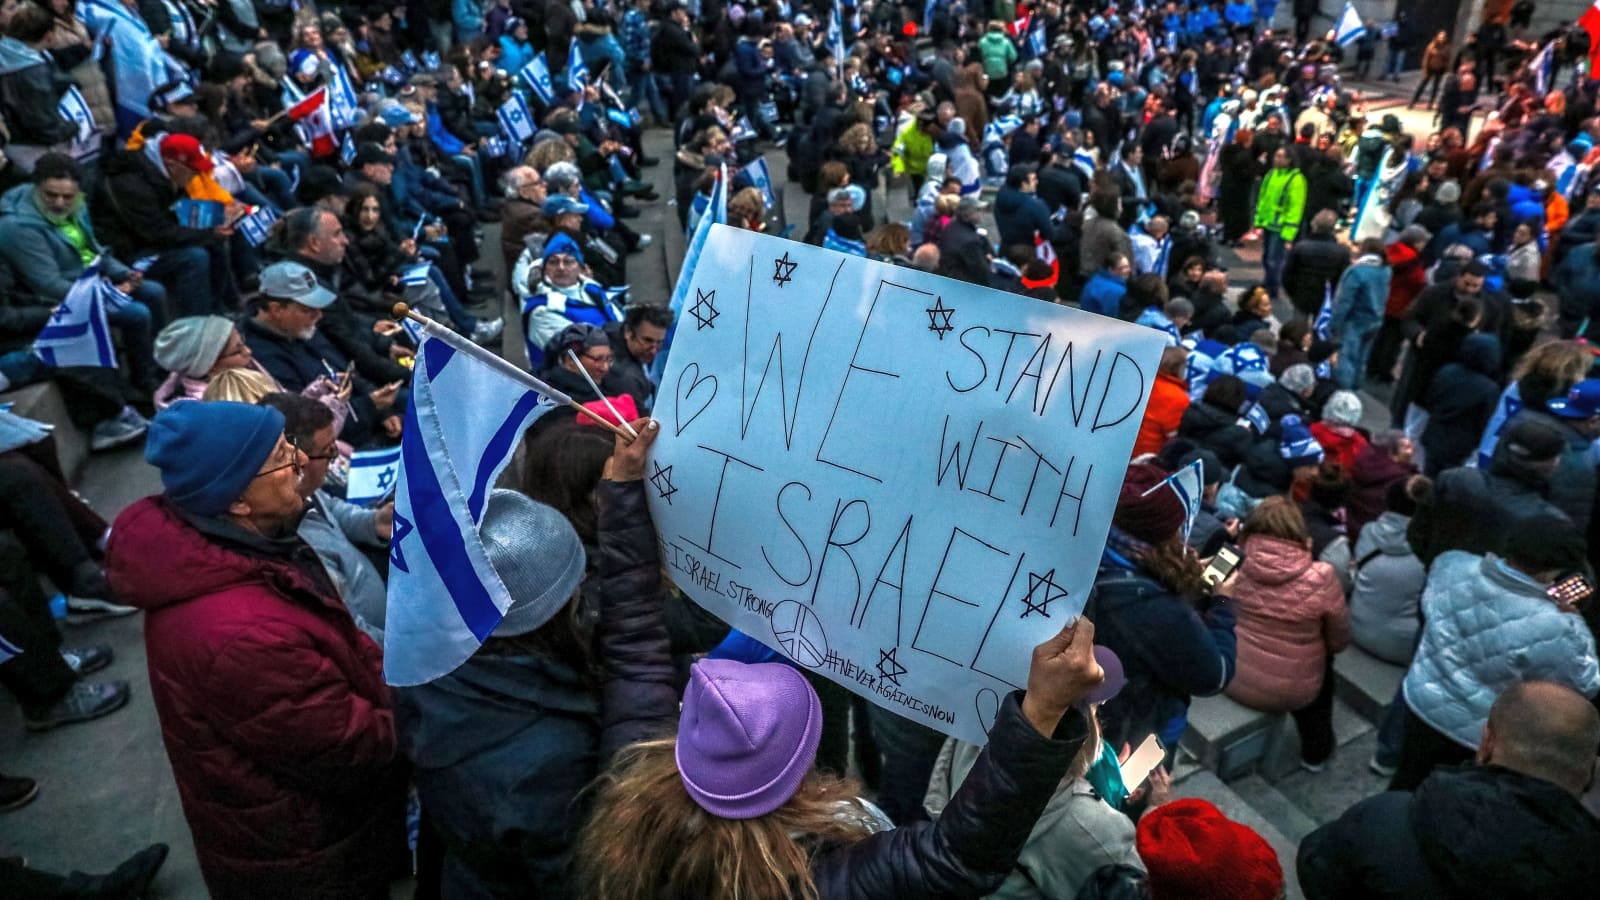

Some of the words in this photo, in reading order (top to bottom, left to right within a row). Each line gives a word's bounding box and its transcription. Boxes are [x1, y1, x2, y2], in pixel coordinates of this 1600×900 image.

[741, 254, 936, 483] WE
[945, 325, 1144, 433] STAND
[937, 414, 1093, 537] WITH
[678, 444, 1026, 692] ISRAEL
